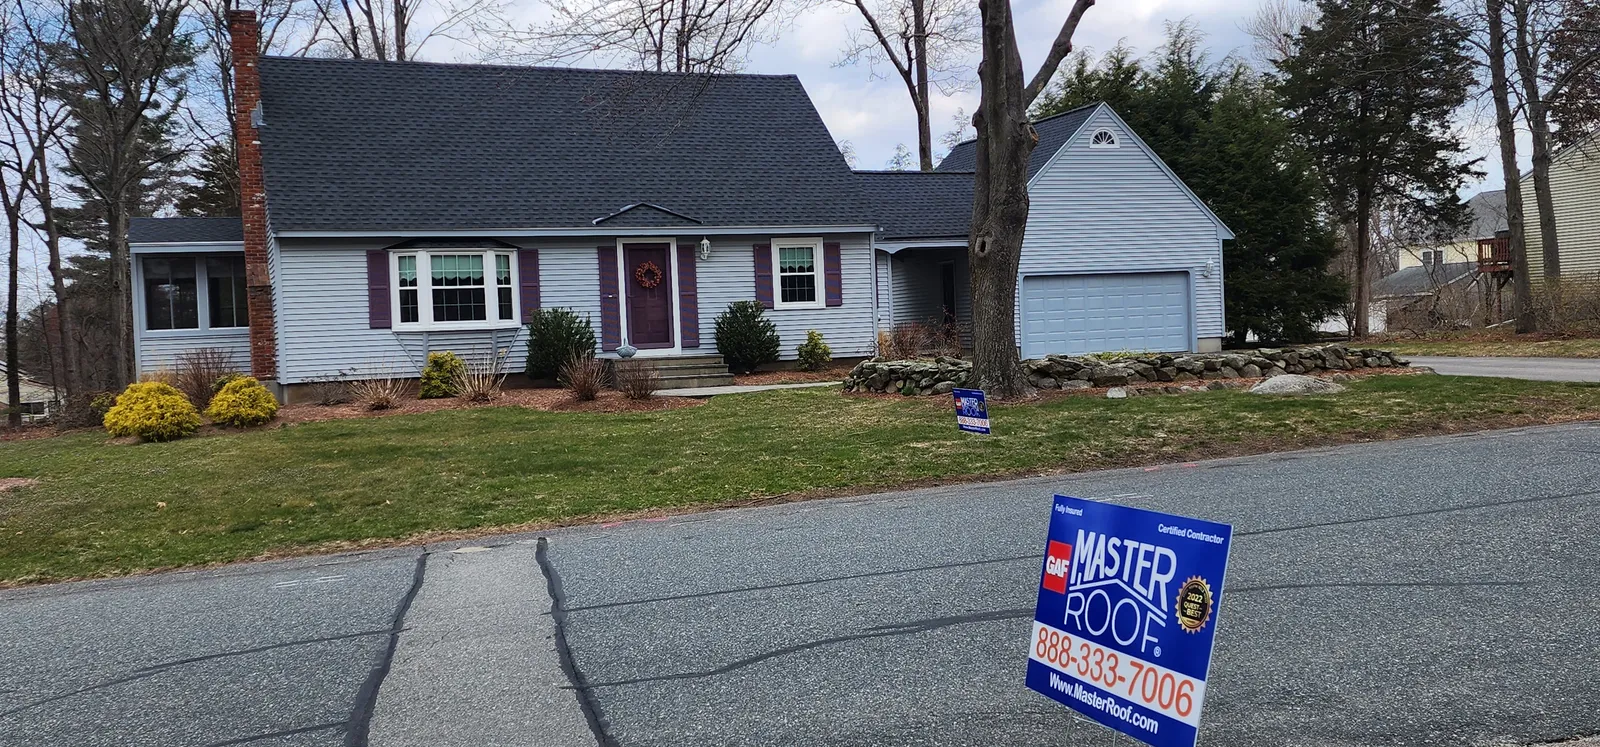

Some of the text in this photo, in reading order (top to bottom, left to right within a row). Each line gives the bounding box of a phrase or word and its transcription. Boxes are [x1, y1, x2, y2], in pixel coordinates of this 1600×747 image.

[1054, 503, 1083, 517] Fully Insured
[1158, 523, 1225, 545] Certified Contractor
[1045, 554, 1070, 578] GAF
[1070, 529, 1177, 612] MASTER
[1183, 601, 1201, 611] QUEST
[1187, 592, 1203, 604] 2022
[1186, 608, 1202, 619] BEST
[1036, 626, 1195, 718] 888-333-7006
[1049, 671, 1159, 735] Www.MasterRoof.com
